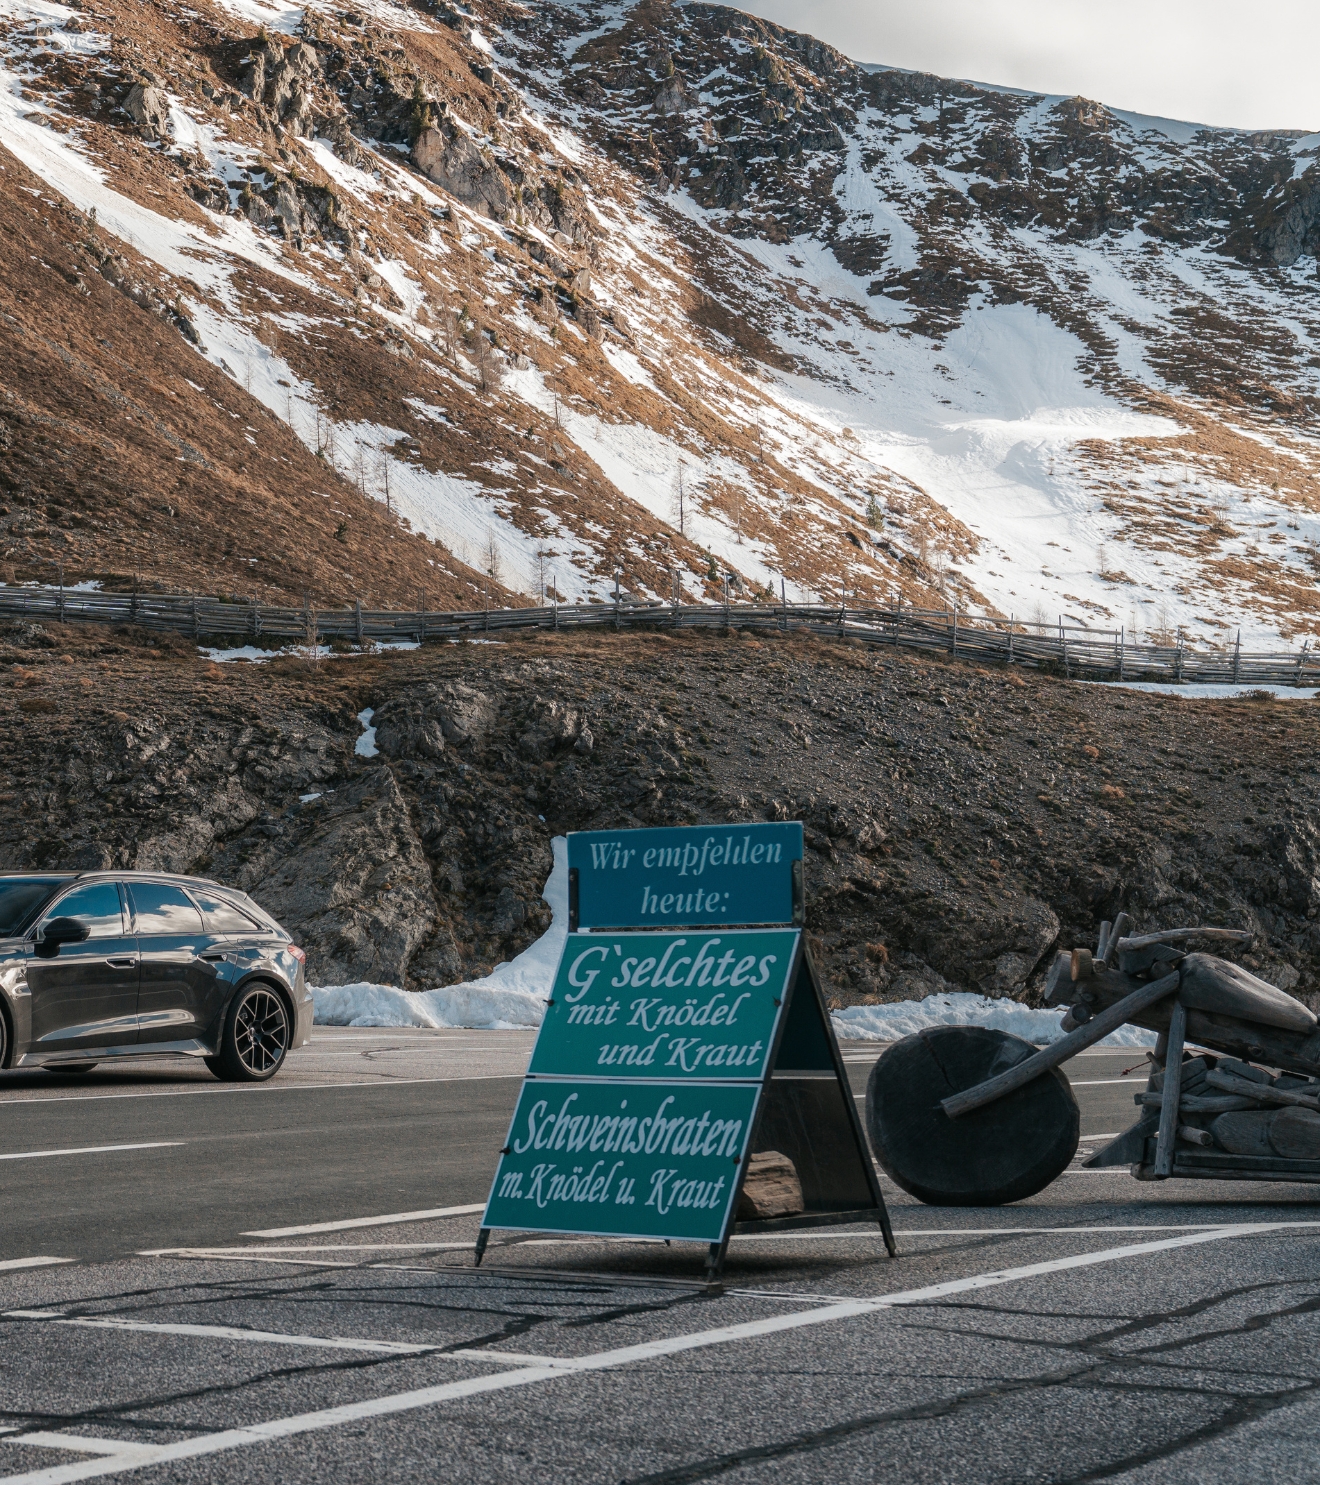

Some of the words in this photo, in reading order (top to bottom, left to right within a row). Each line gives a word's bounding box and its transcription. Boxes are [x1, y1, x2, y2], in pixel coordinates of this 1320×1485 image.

[590, 842, 635, 870] Wir
[643, 836, 782, 875] empfehlen
[641, 886, 730, 914] heute:
[567, 998, 620, 1025] mit
[626, 993, 751, 1031] Knödel
[598, 1034, 669, 1066] und
[665, 1037, 764, 1073] Kraut
[514, 1093, 742, 1157] Schweinsbraten
[615, 1177, 636, 1205] u.
[645, 1169, 727, 1214] Kraut
